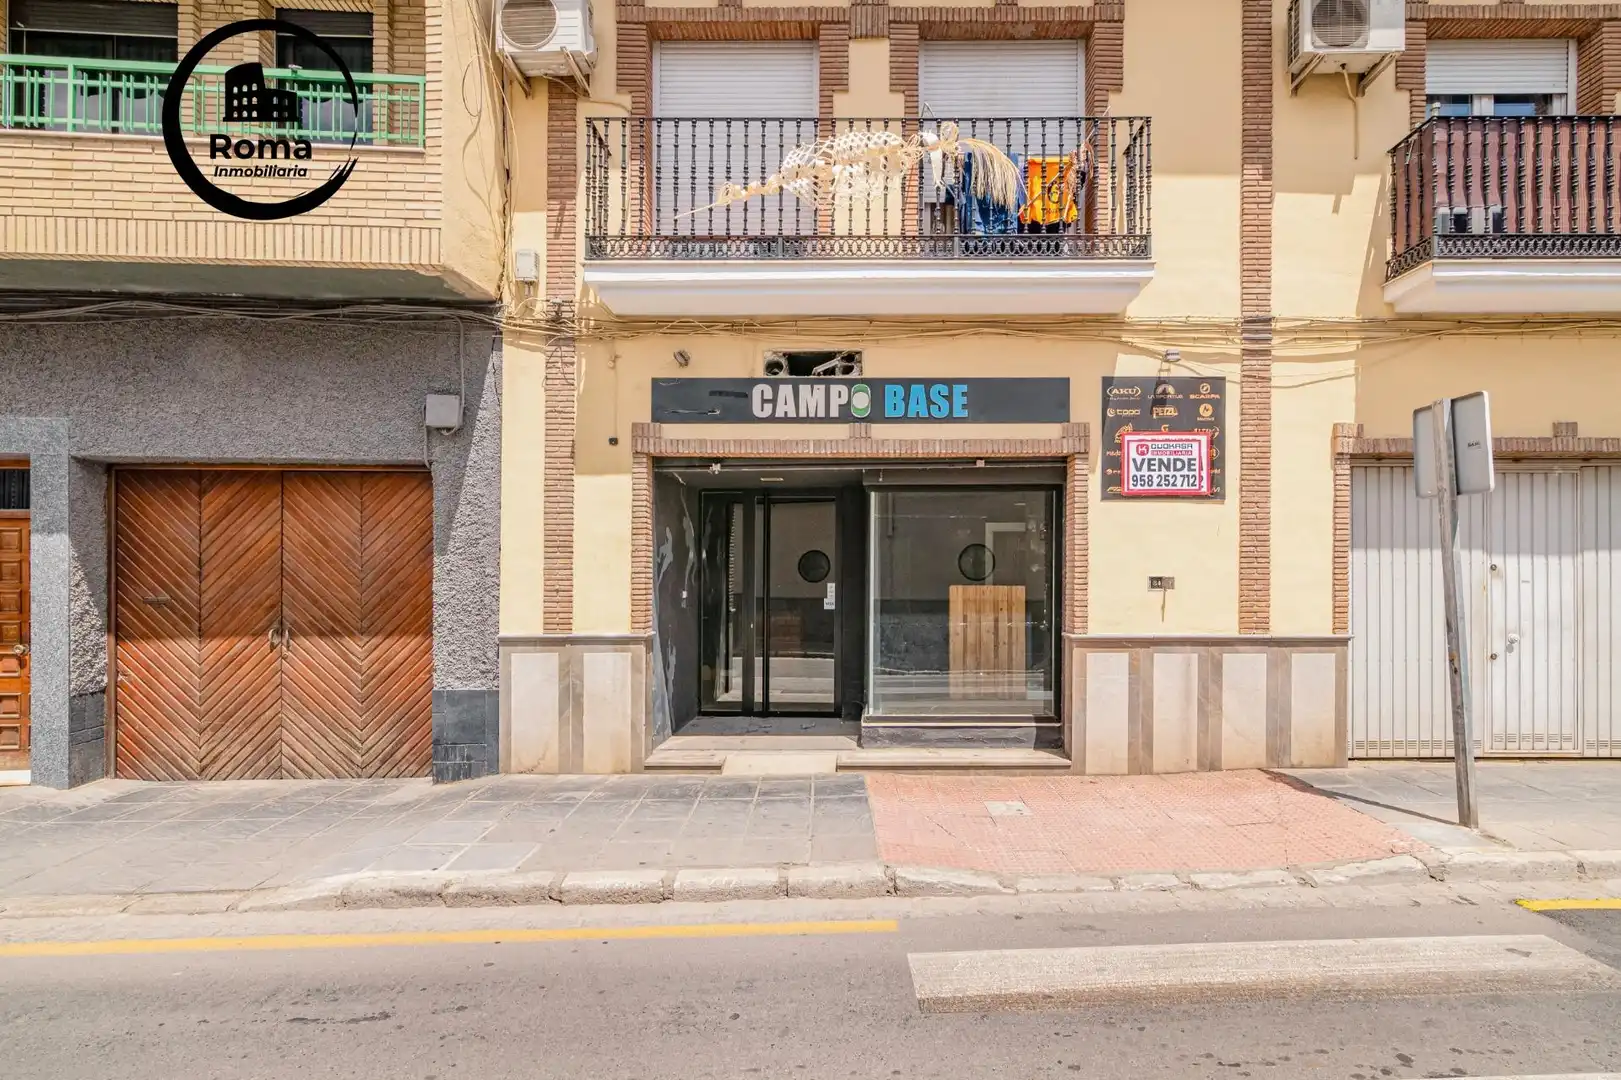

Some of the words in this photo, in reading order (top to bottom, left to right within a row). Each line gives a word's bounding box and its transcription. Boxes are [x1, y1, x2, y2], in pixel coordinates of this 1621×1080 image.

[884, 384, 969, 417] BASE
[1131, 457, 1197, 472] VENDE
[1131, 474, 1154, 488] 958
[1156, 474, 1177, 488] 252
[1180, 474, 1197, 488] 712
